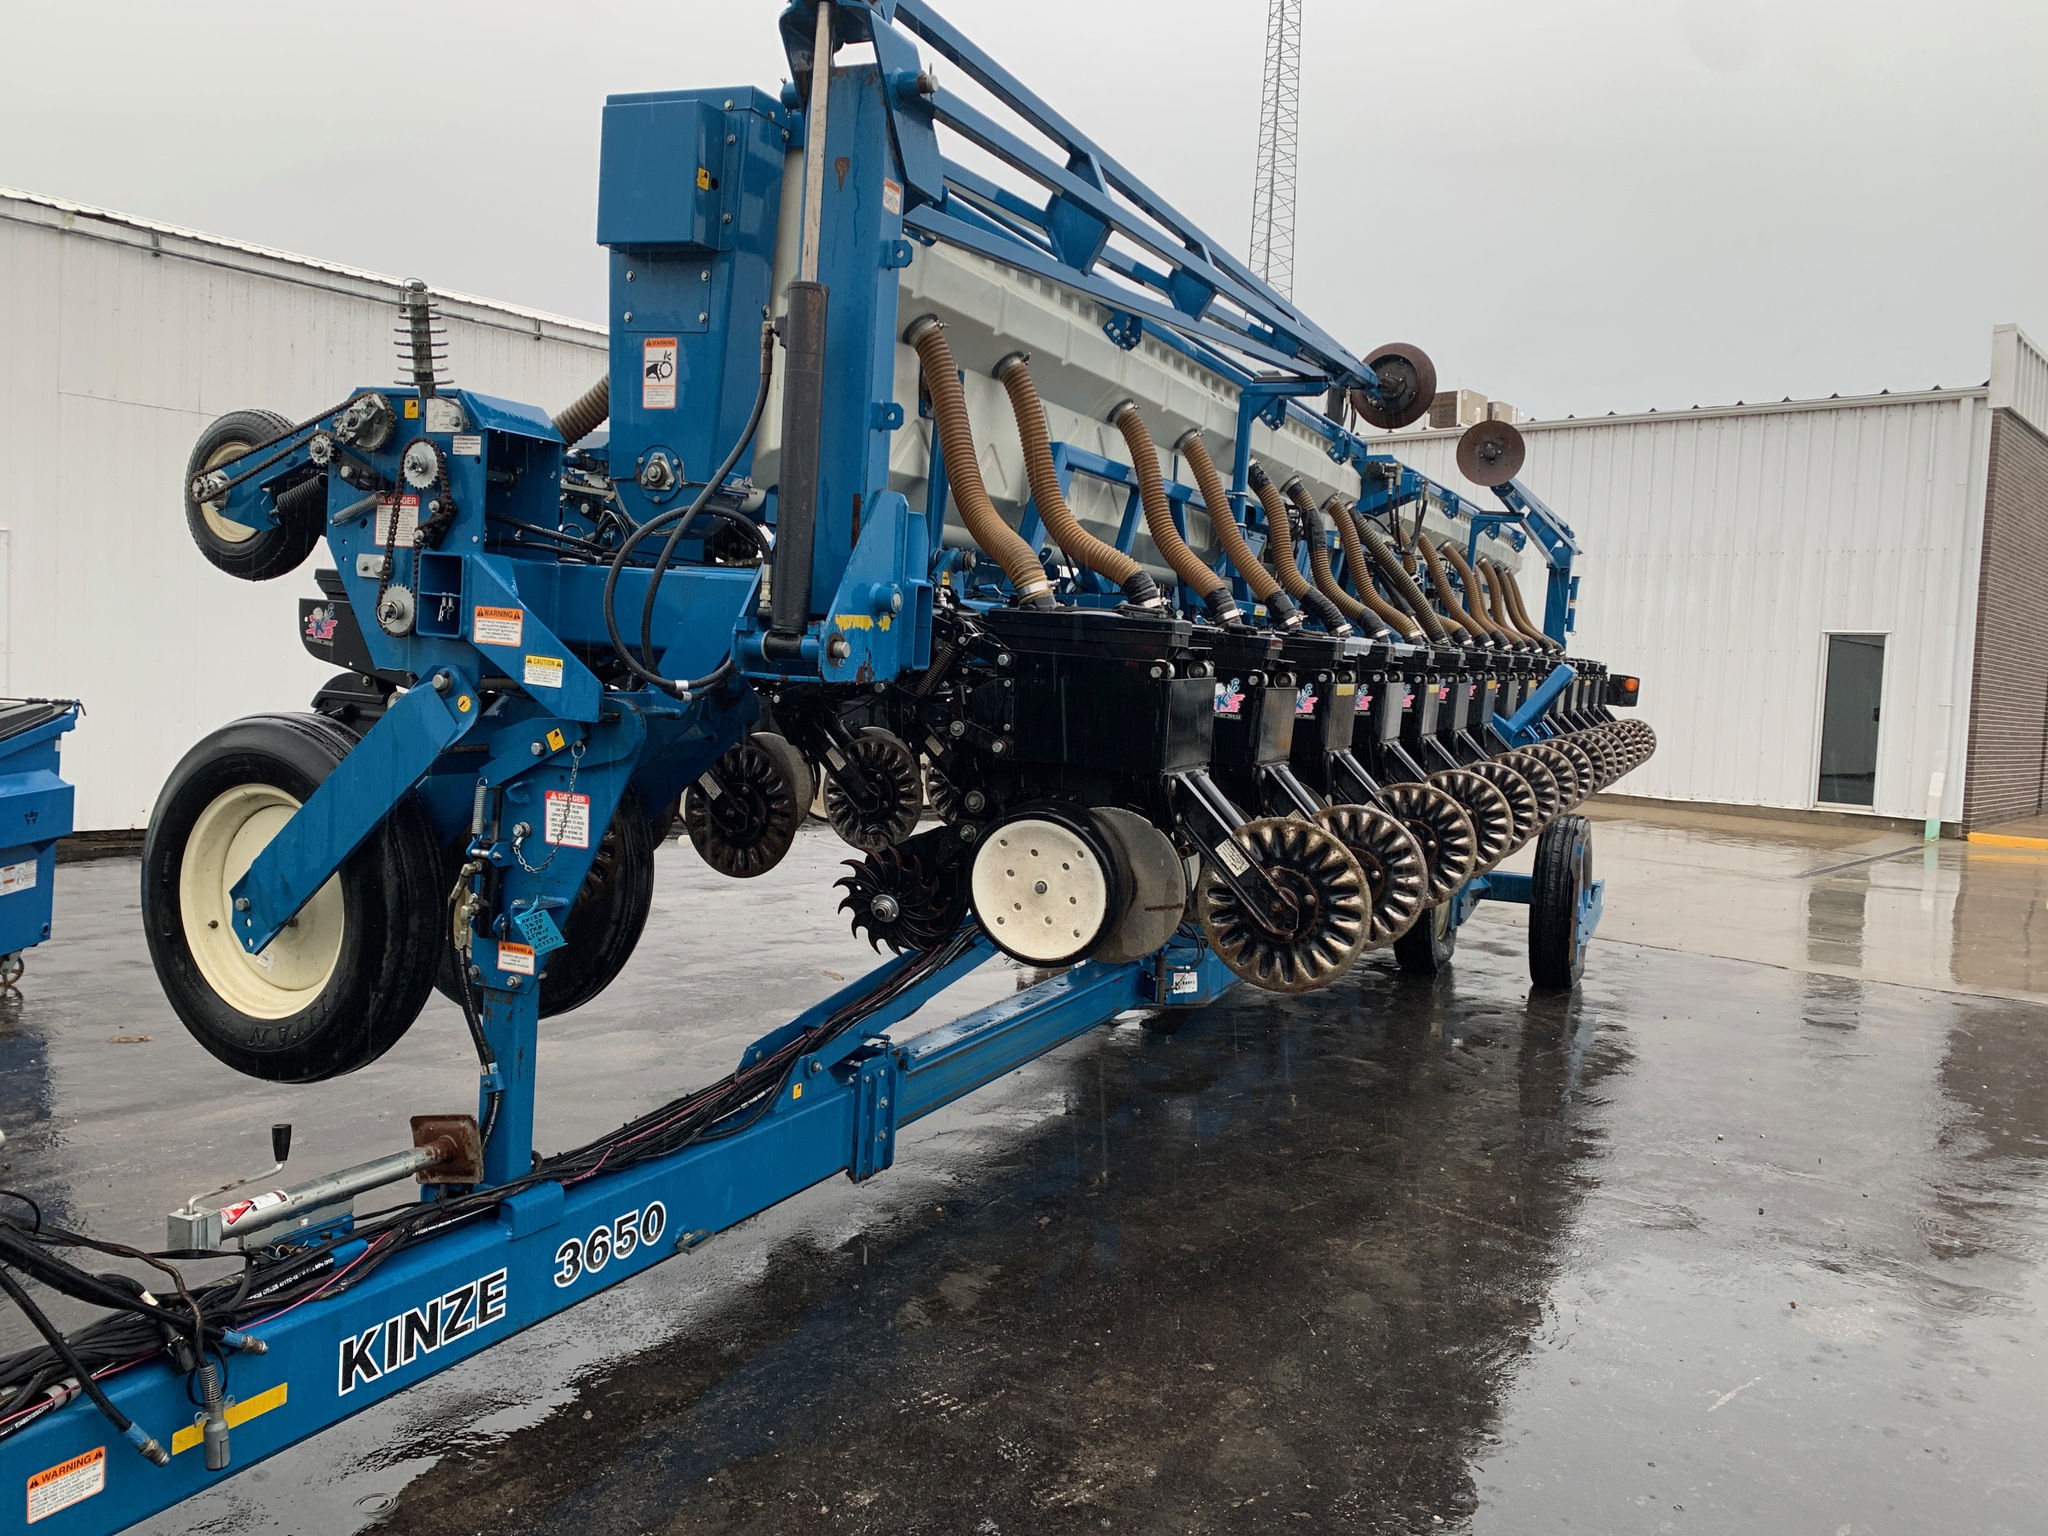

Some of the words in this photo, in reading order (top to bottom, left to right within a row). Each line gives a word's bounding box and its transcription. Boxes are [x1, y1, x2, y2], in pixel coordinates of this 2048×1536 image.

[388, 496, 416, 504] DGER
[484, 609, 513, 618] WARNING
[533, 658, 555, 666] CAUTION
[558, 793, 586, 803] DAGER
[554, 1200, 667, 1288] 3650
[338, 1267, 508, 1396] KINZE
[41, 1455, 92, 1483] WARNING
